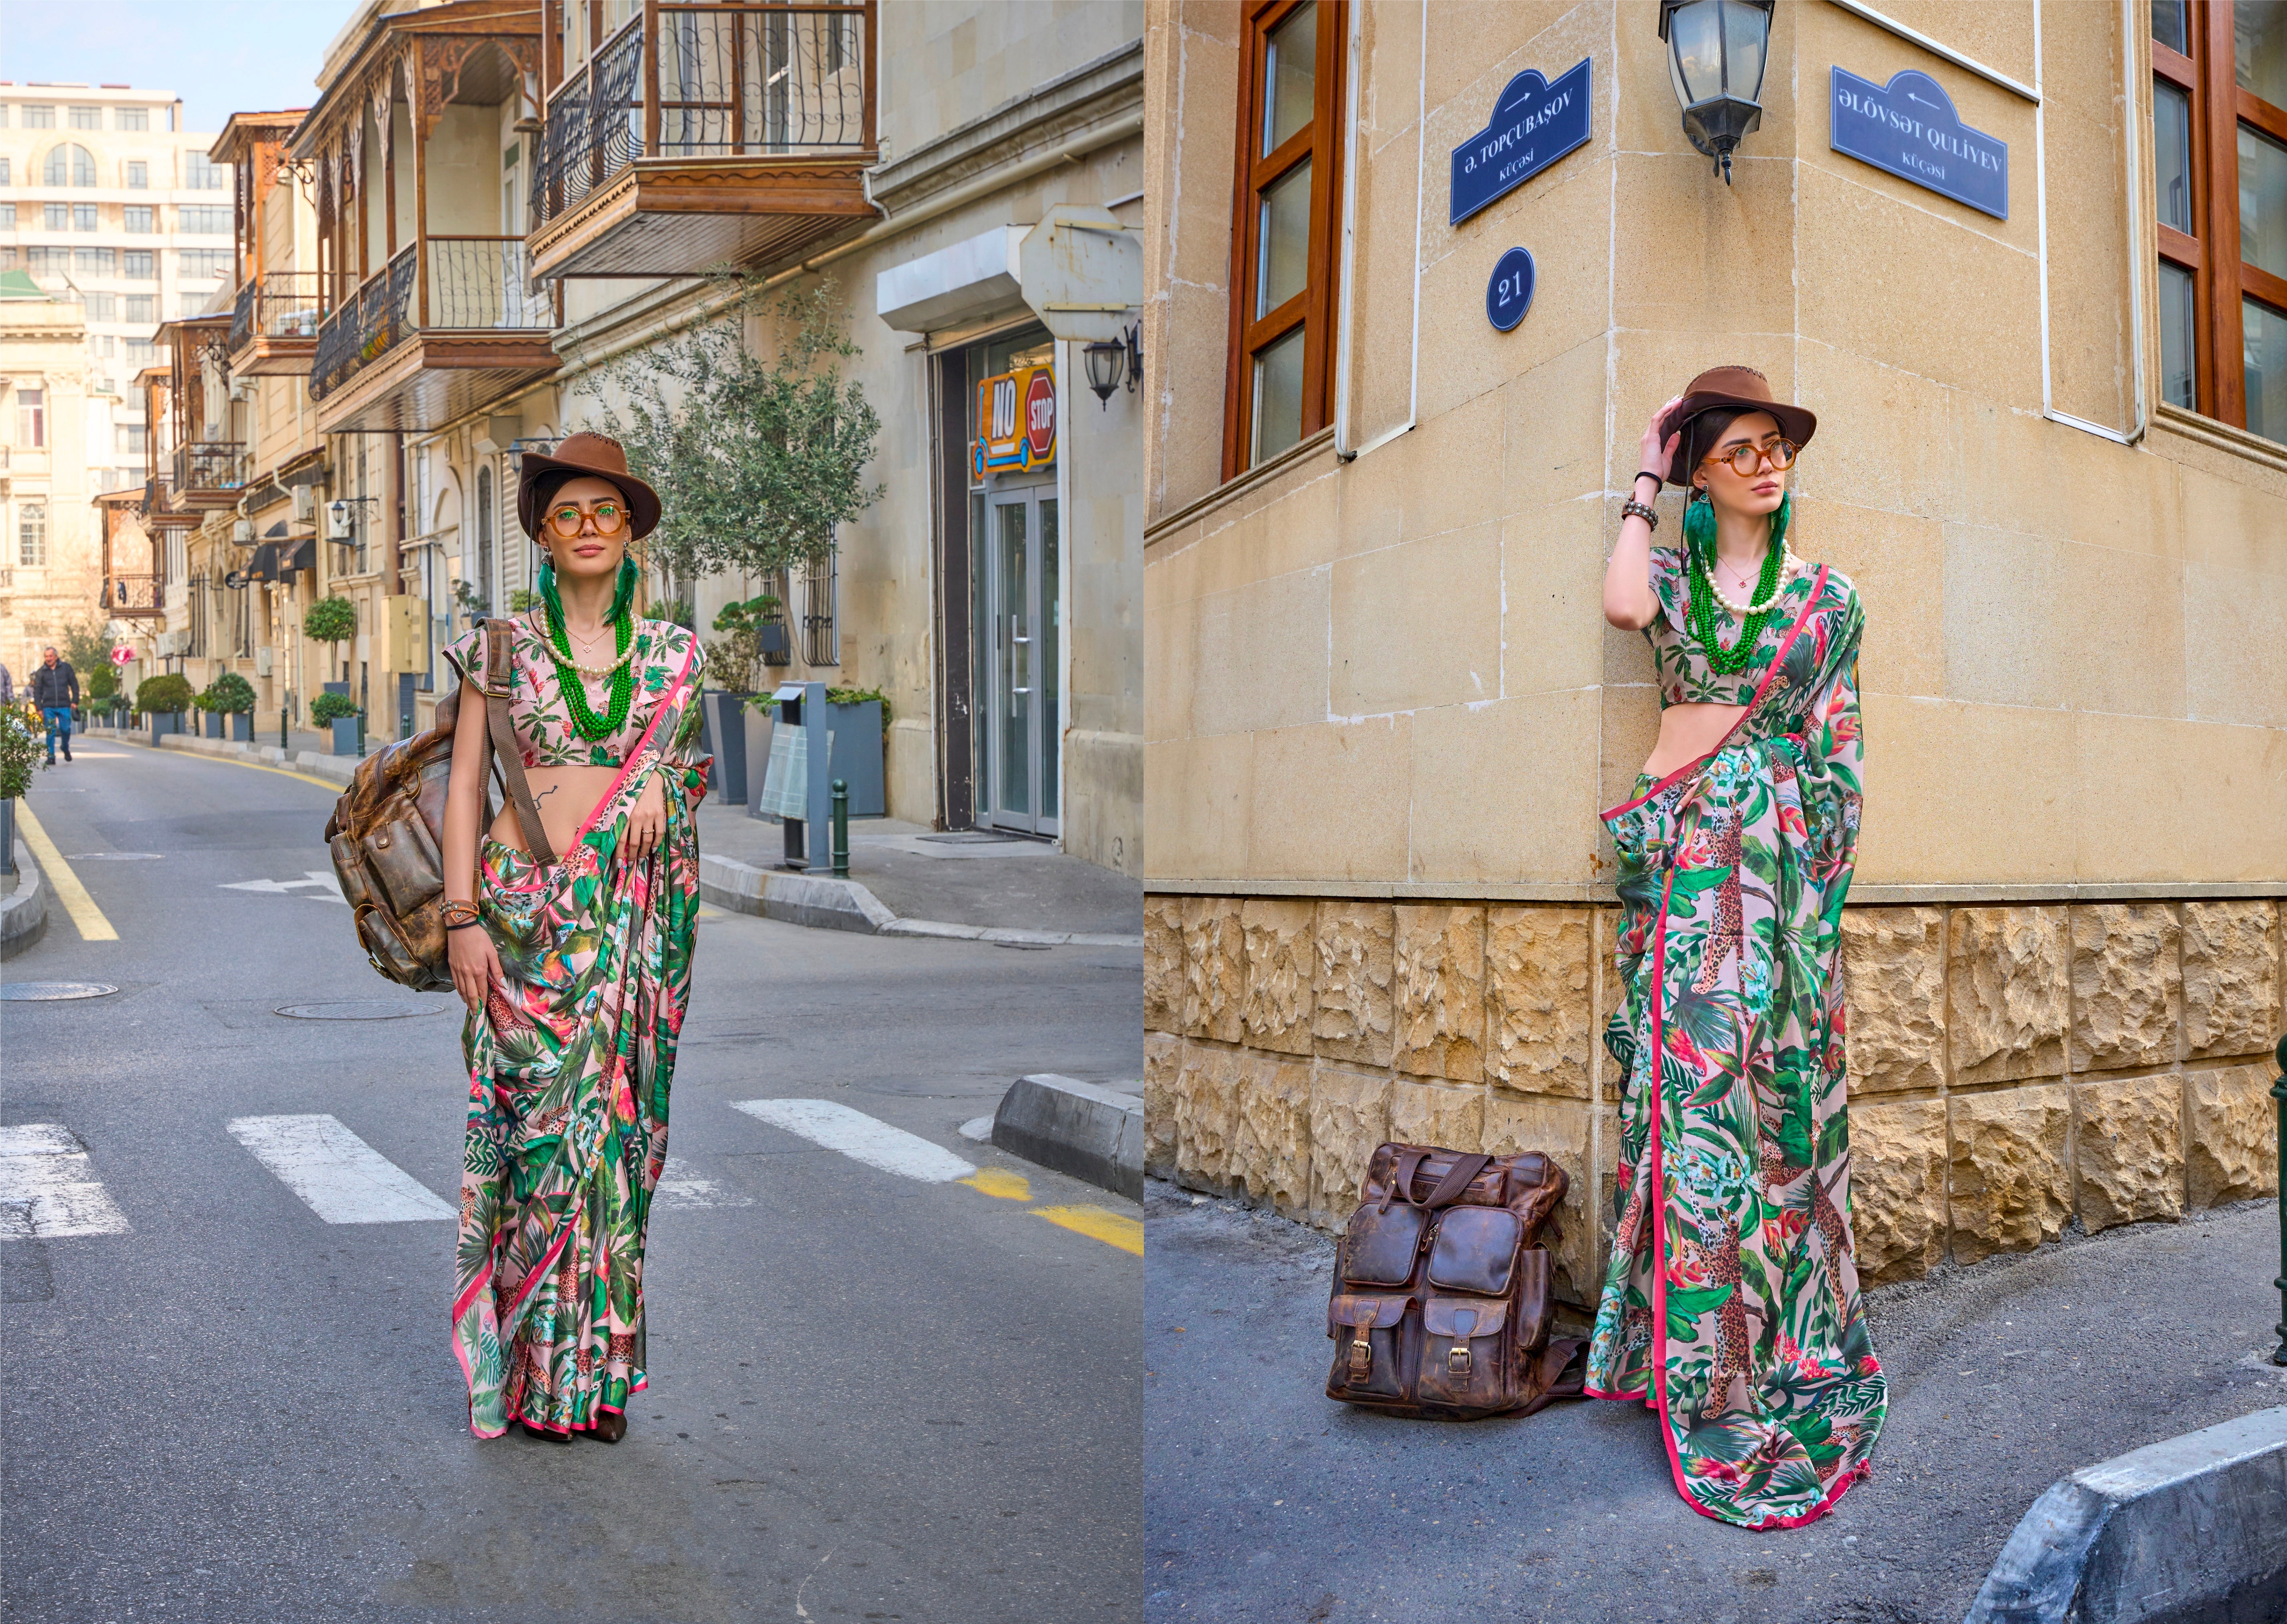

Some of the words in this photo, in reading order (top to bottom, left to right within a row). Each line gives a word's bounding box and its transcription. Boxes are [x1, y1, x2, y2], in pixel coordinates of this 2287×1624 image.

[1465, 156, 1477, 173] Ə.
[1480, 88, 1573, 163] TOPÇUBAŞOV
[1839, 88, 1923, 139] ƏLÖVSƏT
[1927, 128, 2002, 173] QULİYEV
[1499, 148, 1533, 181] KÜÇƏSİ
[1902, 152, 1945, 180] KÜÇƏSİ
[1499, 271, 1521, 307] 21
[992, 380, 1016, 438] NO
[1031, 398, 1053, 431] STOP
